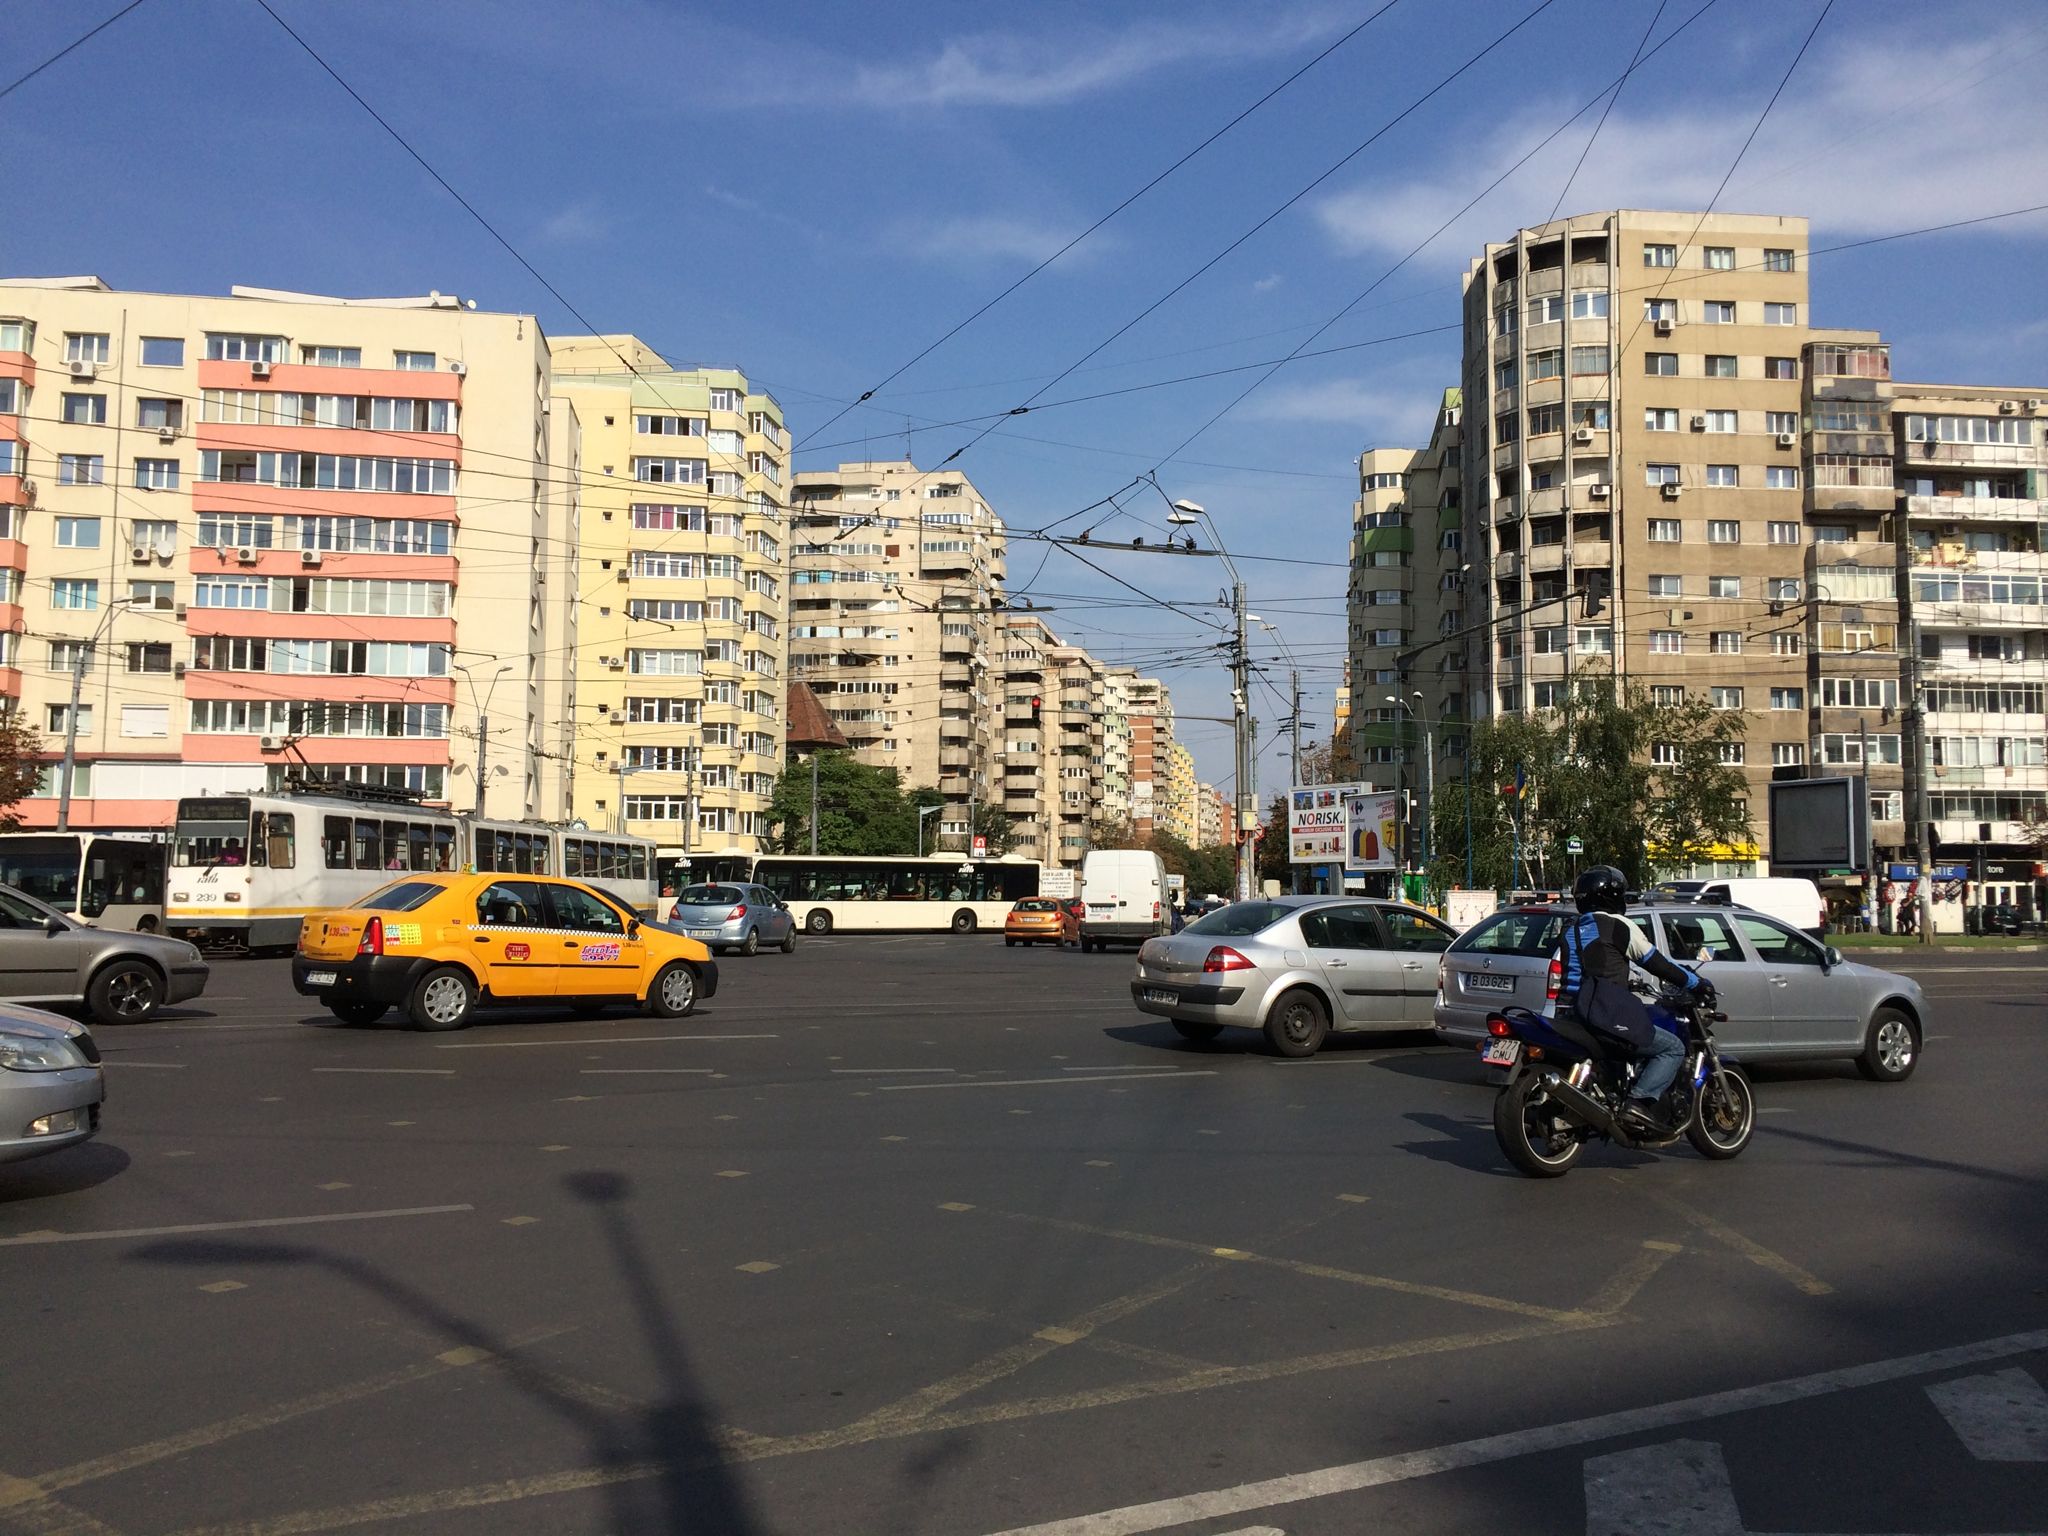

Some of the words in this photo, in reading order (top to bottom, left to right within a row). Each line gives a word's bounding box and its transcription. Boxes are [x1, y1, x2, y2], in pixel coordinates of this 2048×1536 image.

[1298, 811, 1344, 826] NORISK.
[1906, 866, 1954, 876] FLARIE
[1986, 865, 2004, 874] tore
[196, 893, 217, 902] 239
[1471, 975, 1478, 986] B
[1480, 976, 1490, 987] 03
[1491, 976, 1510, 989] GZE
[1492, 1040, 1499, 1049] B
[1500, 1040, 1518, 1050] 777
[1492, 1050, 1512, 1061] CMU
